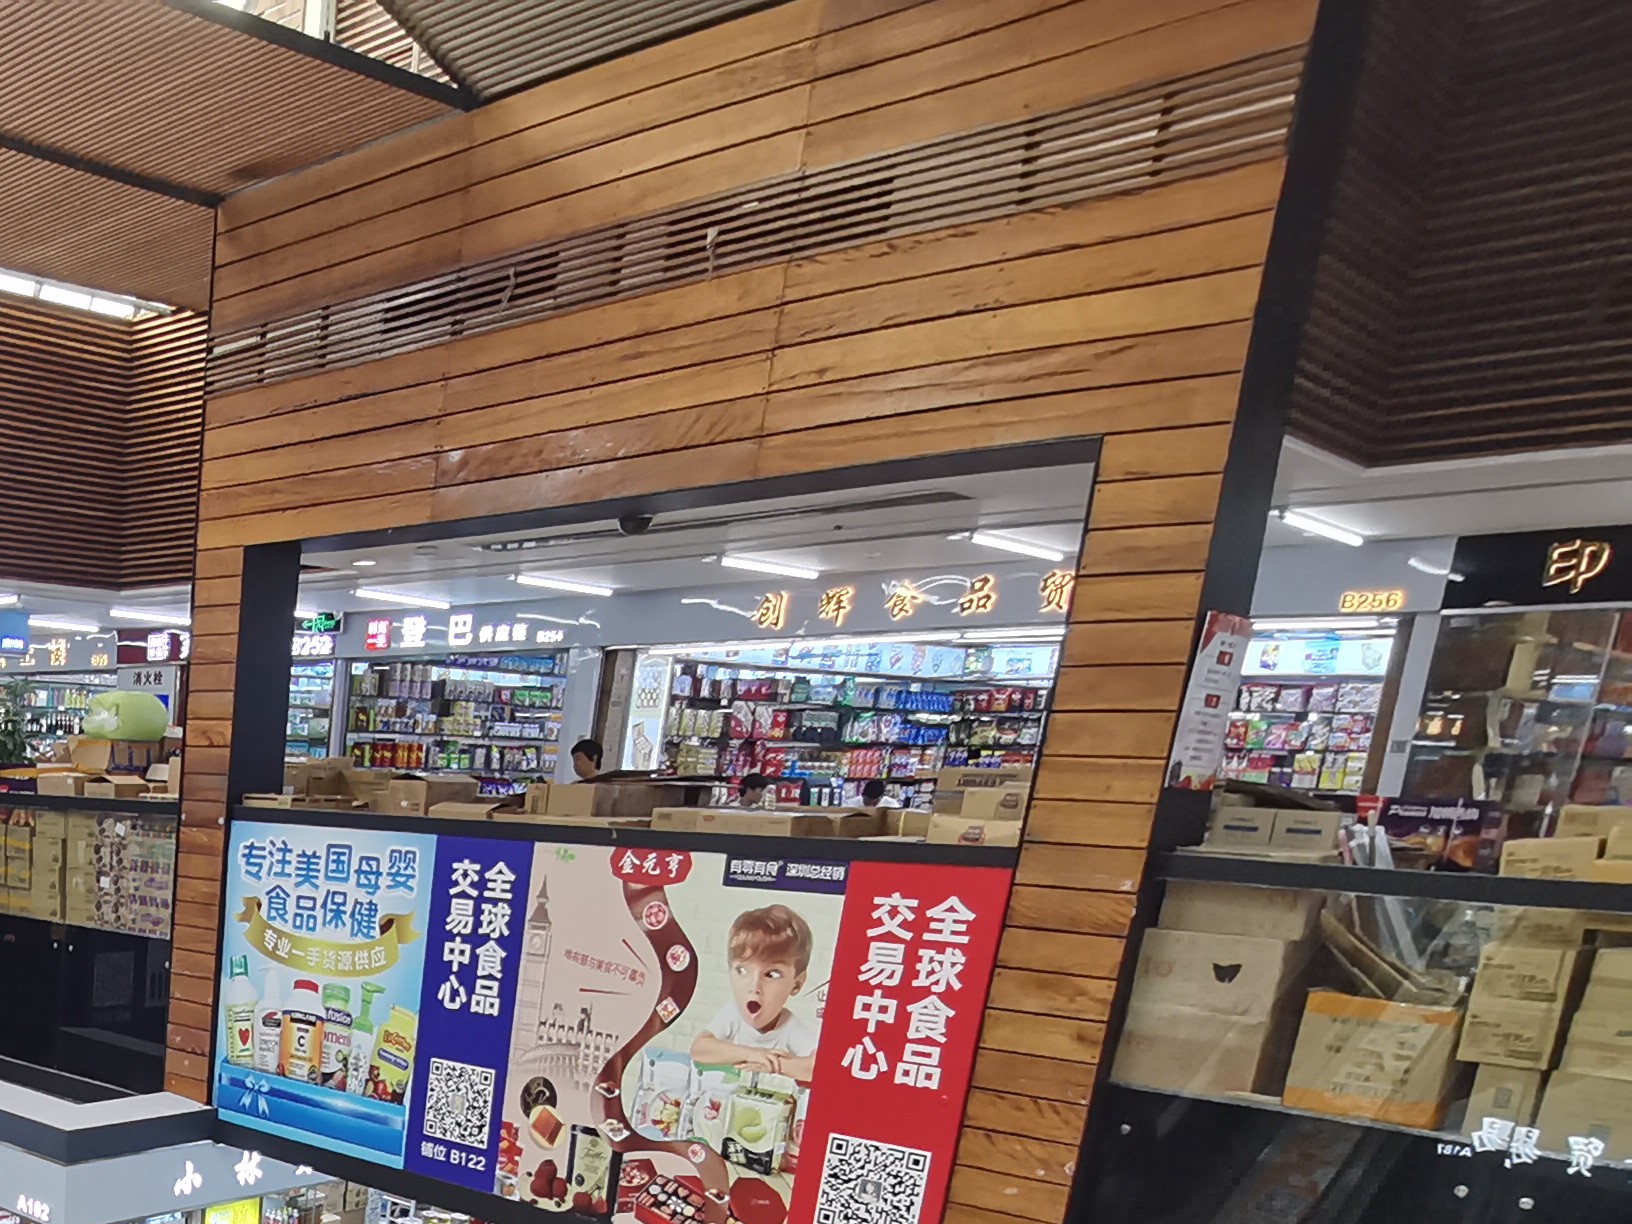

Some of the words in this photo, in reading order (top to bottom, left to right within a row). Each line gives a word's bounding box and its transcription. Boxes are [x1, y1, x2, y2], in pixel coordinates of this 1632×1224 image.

[752, 570, 1076, 631] 创辉食品贸
[1340, 591, 1402, 611] B256
[132, 671, 165, 688] 消火栓
[240, 837, 420, 896] 专注美国母婴
[616, 851, 687, 879] 金元亨
[264, 884, 380, 941] 食品保健
[437, 858, 482, 1011] 交易中心
[262, 928, 388, 972] 专业一手货源供应
[469, 861, 517, 1017] 全球食品
[841, 892, 920, 1081] 交易中心
[894, 895, 977, 1090] 全球食品
[297, 1034, 306, 1048] C
[174, 1151, 313, 1197] 小林
[419, 1140, 447, 1163] 铺位
[449, 1147, 487, 1172] B122
